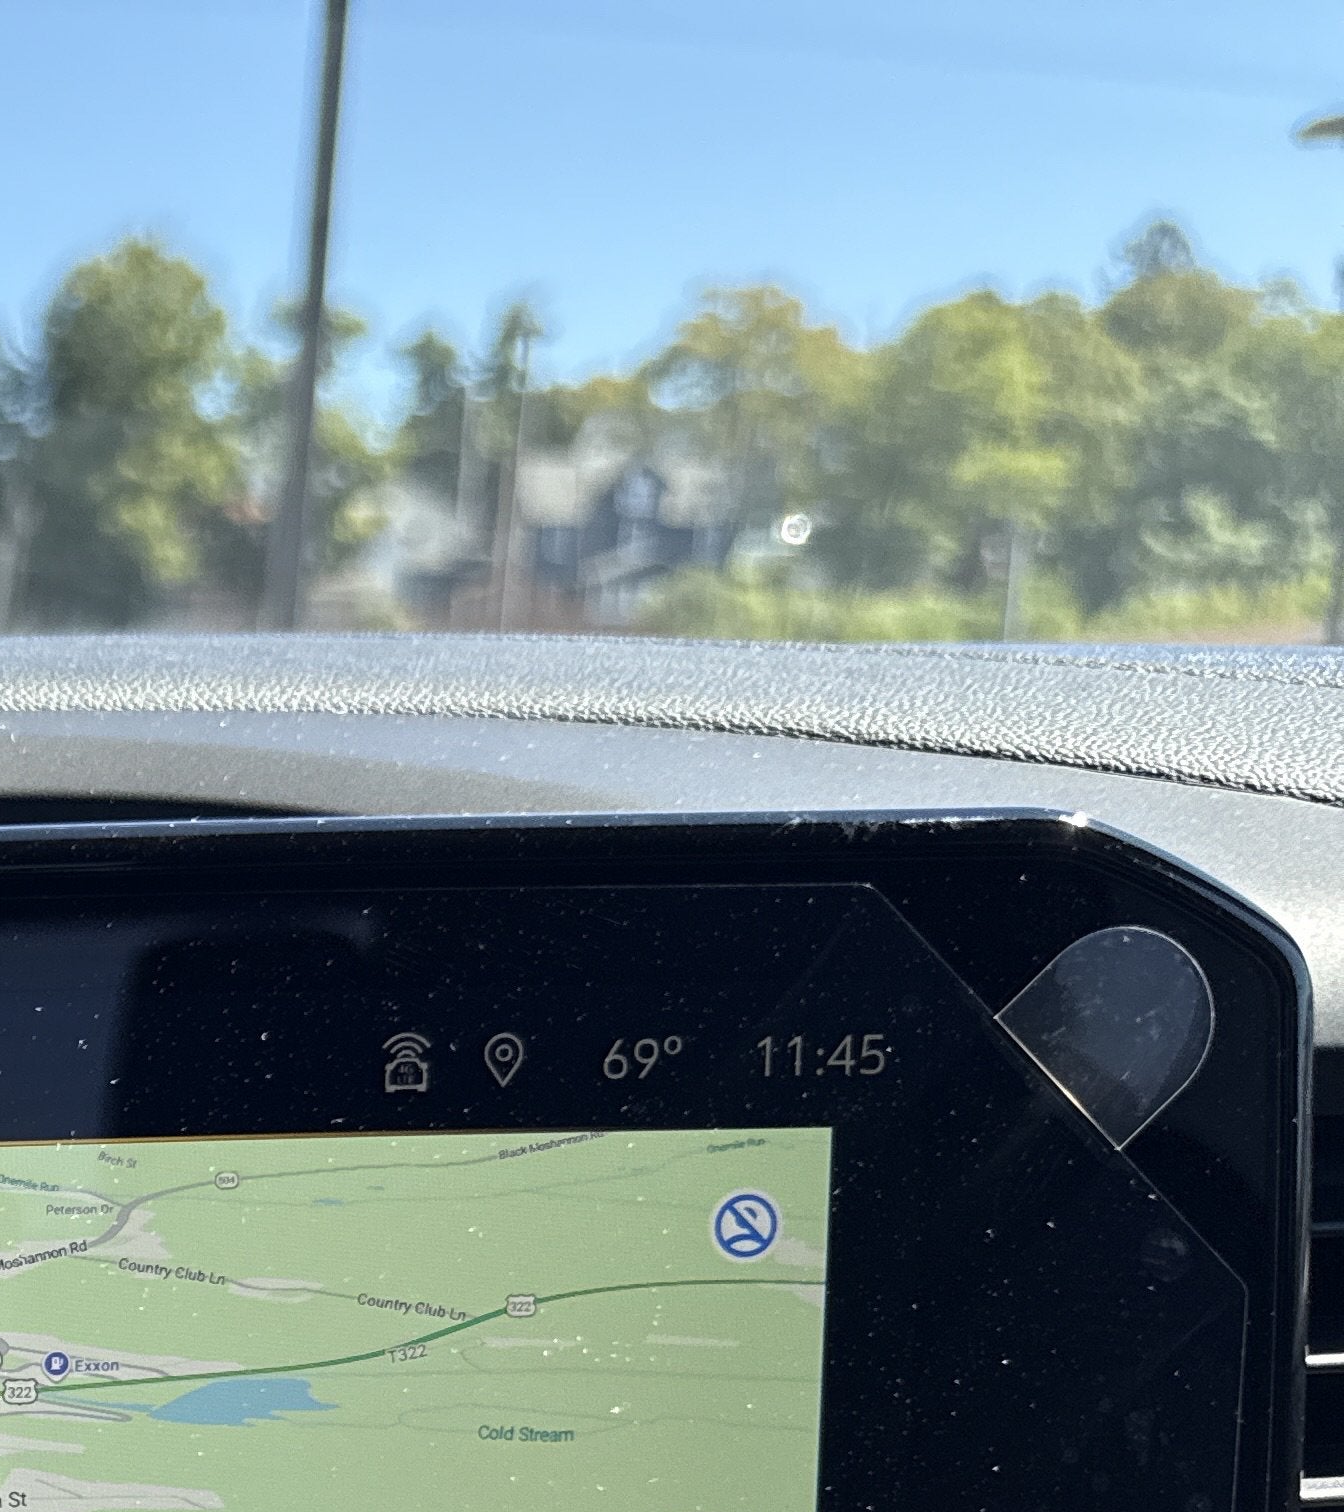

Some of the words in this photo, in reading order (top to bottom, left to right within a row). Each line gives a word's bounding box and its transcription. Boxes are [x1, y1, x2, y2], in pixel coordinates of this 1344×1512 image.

[757, 1034, 887, 1077] 11:45
[46, 1204, 97, 1216] Peterson
[69, 1240, 88, 1254] Rd
[118, 1258, 172, 1279] Country
[174, 1267, 206, 1282] Club
[209, 1272, 226, 1285] Ln
[509, 1301, 531, 1313] 322
[387, 1344, 428, 1363] T322
[75, 1358, 120, 1373] Exxon
[7, 1385, 32, 1400] 322
[478, 1425, 513, 1441] Cold
[519, 1426, 575, 1442] Stream
[7, 1491, 28, 1508] St
